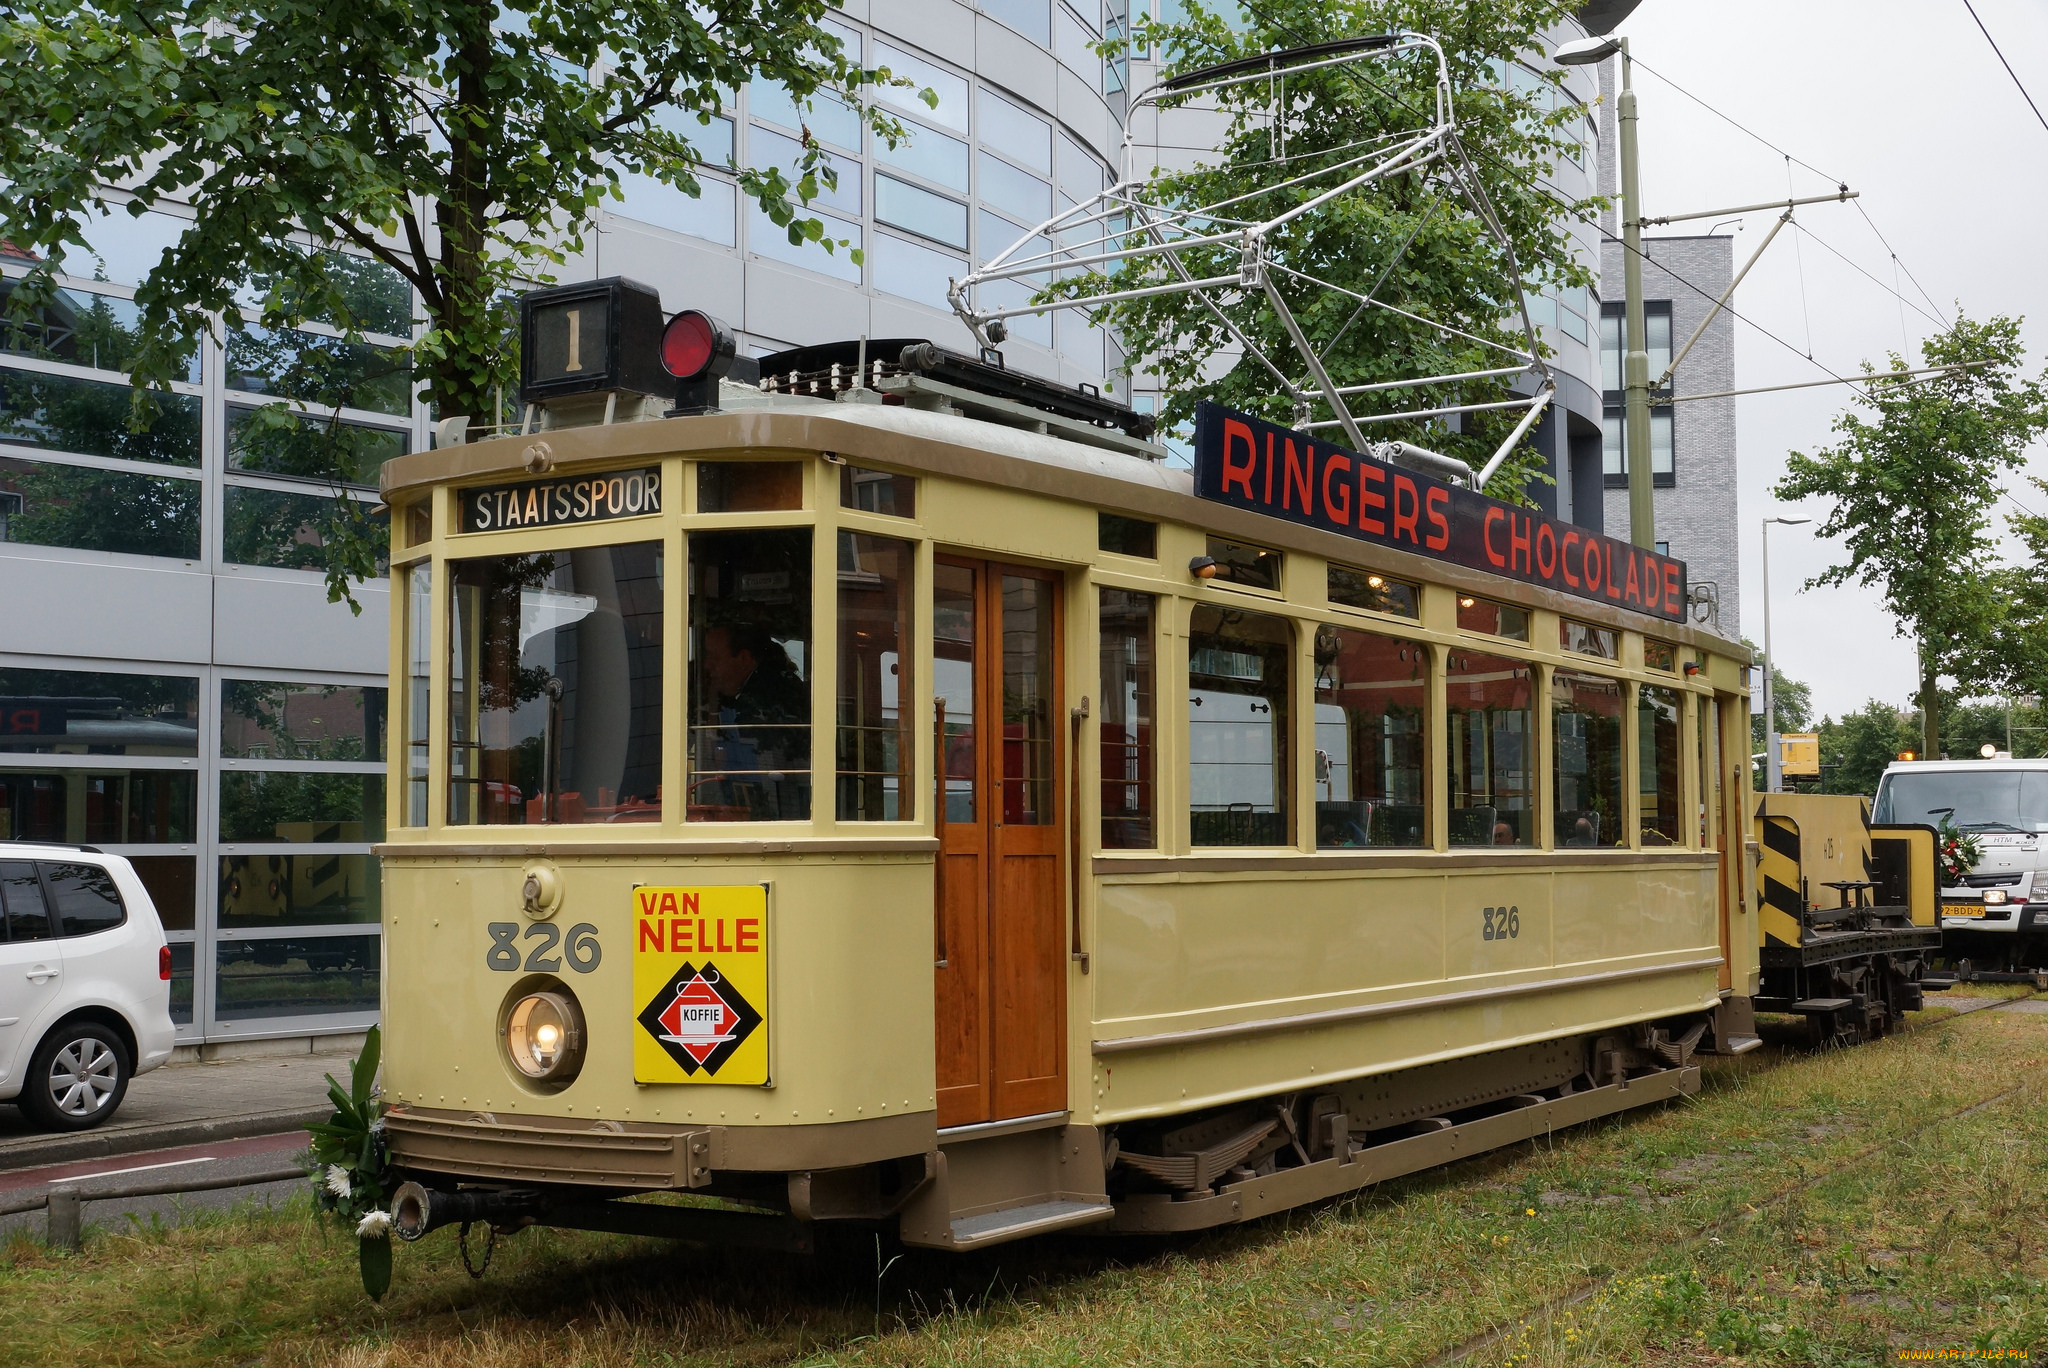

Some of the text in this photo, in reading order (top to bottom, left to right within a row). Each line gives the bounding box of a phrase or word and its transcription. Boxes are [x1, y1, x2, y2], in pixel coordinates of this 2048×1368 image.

[566, 310, 583, 372] 1
[476, 472, 661, 529] STAATSSPOOR
[1221, 417, 1680, 615] RINGERS CHOCOLADE
[639, 892, 700, 915] VAN
[1482, 905, 1520, 941] 826
[486, 921, 602, 974] 826
[639, 918, 759, 953] NELLE
[683, 1008, 720, 1022] KOFFIE
